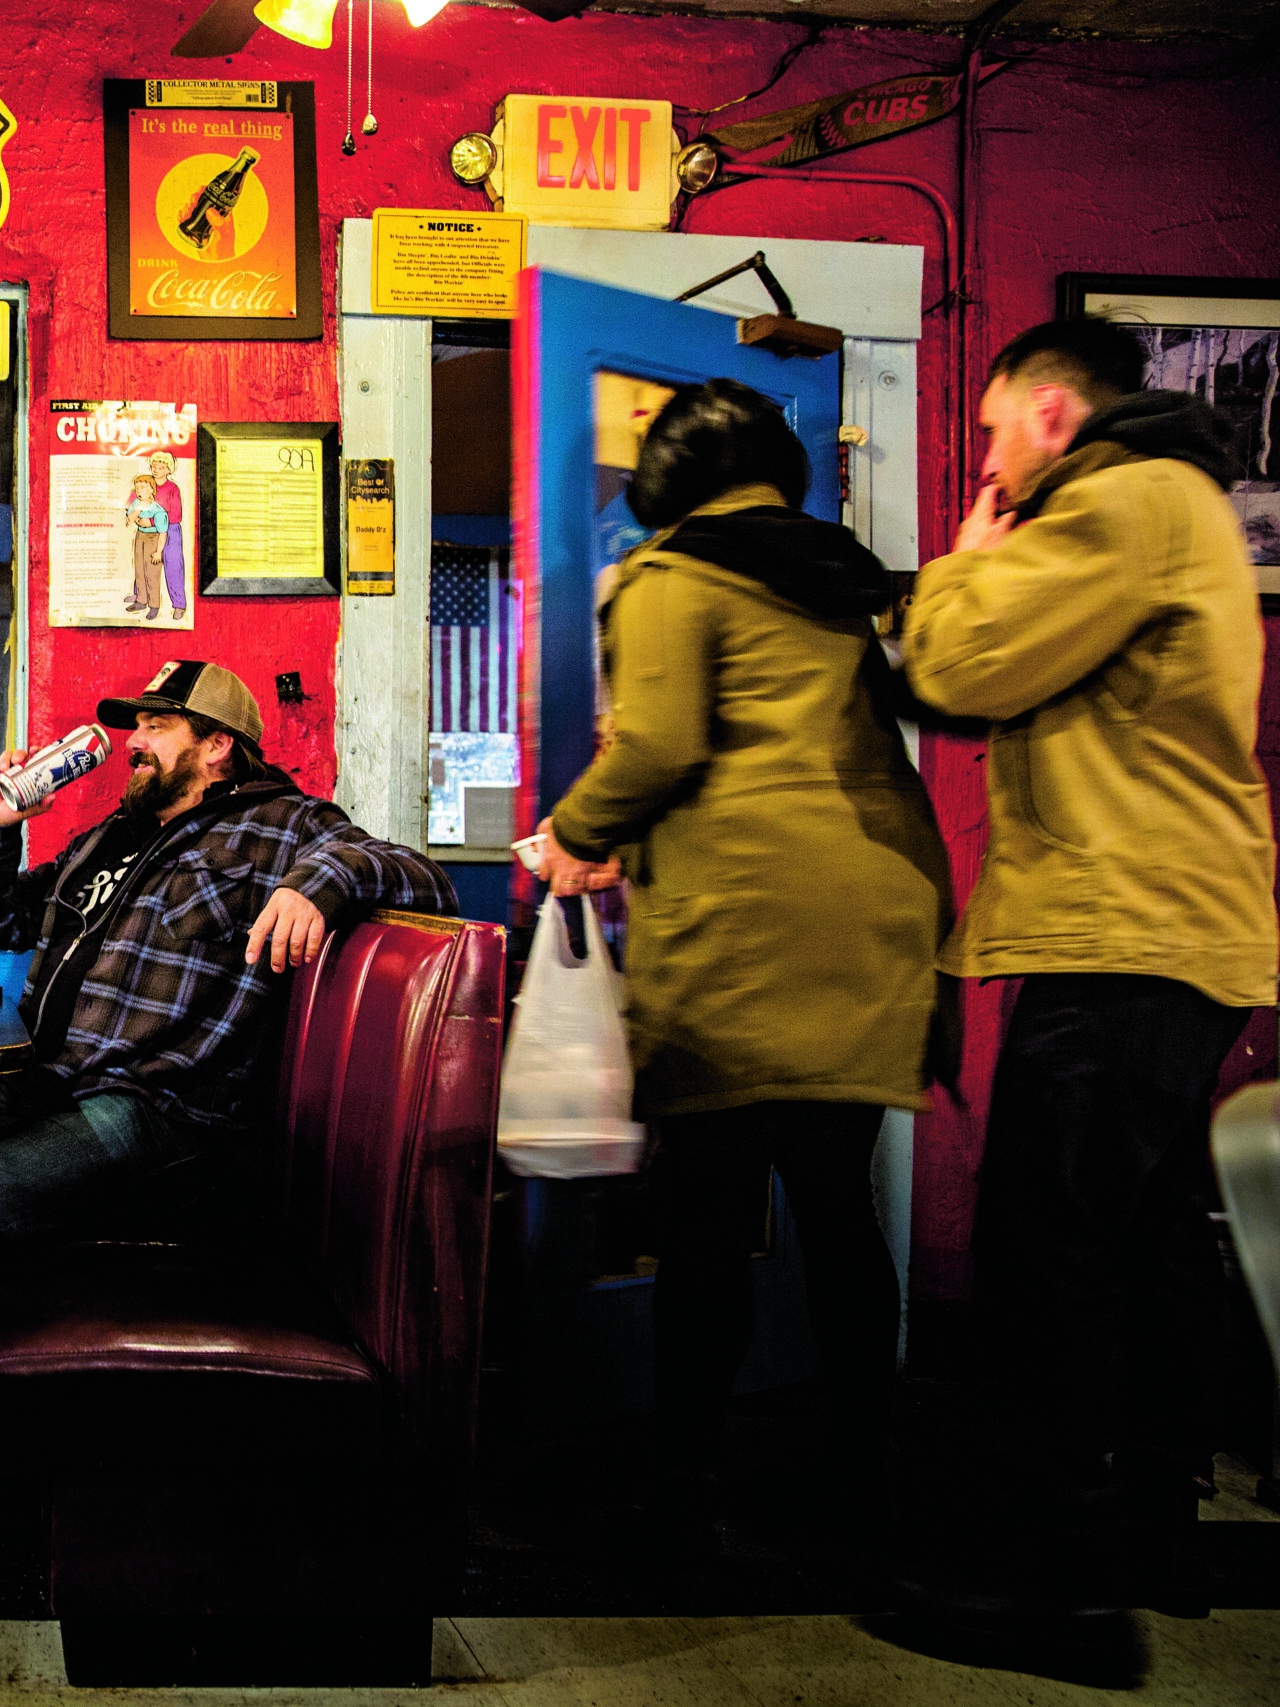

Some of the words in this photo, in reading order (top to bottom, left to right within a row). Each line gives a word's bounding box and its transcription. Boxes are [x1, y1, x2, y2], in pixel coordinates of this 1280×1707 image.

[163, 80, 208, 88] COLLECTOR
[237, 81, 260, 89] SIGNS
[843, 94, 929, 126] CUBS
[141, 118, 166, 134] It's
[172, 118, 198, 134] the
[203, 120, 235, 135] real
[241, 120, 283, 141] thing
[536, 104, 652, 192] EXIT
[427, 222, 475, 232] NOTICE
[137, 258, 179, 268] DRINK
[147, 268, 283, 311] Coca-Cola
[52, 402, 80, 410] FIRST
[56, 416, 191, 445] CHOKING
[357, 478, 374, 486] Best
[351, 485, 390, 495] Citysearch
[355, 526, 375, 534] Daddy
